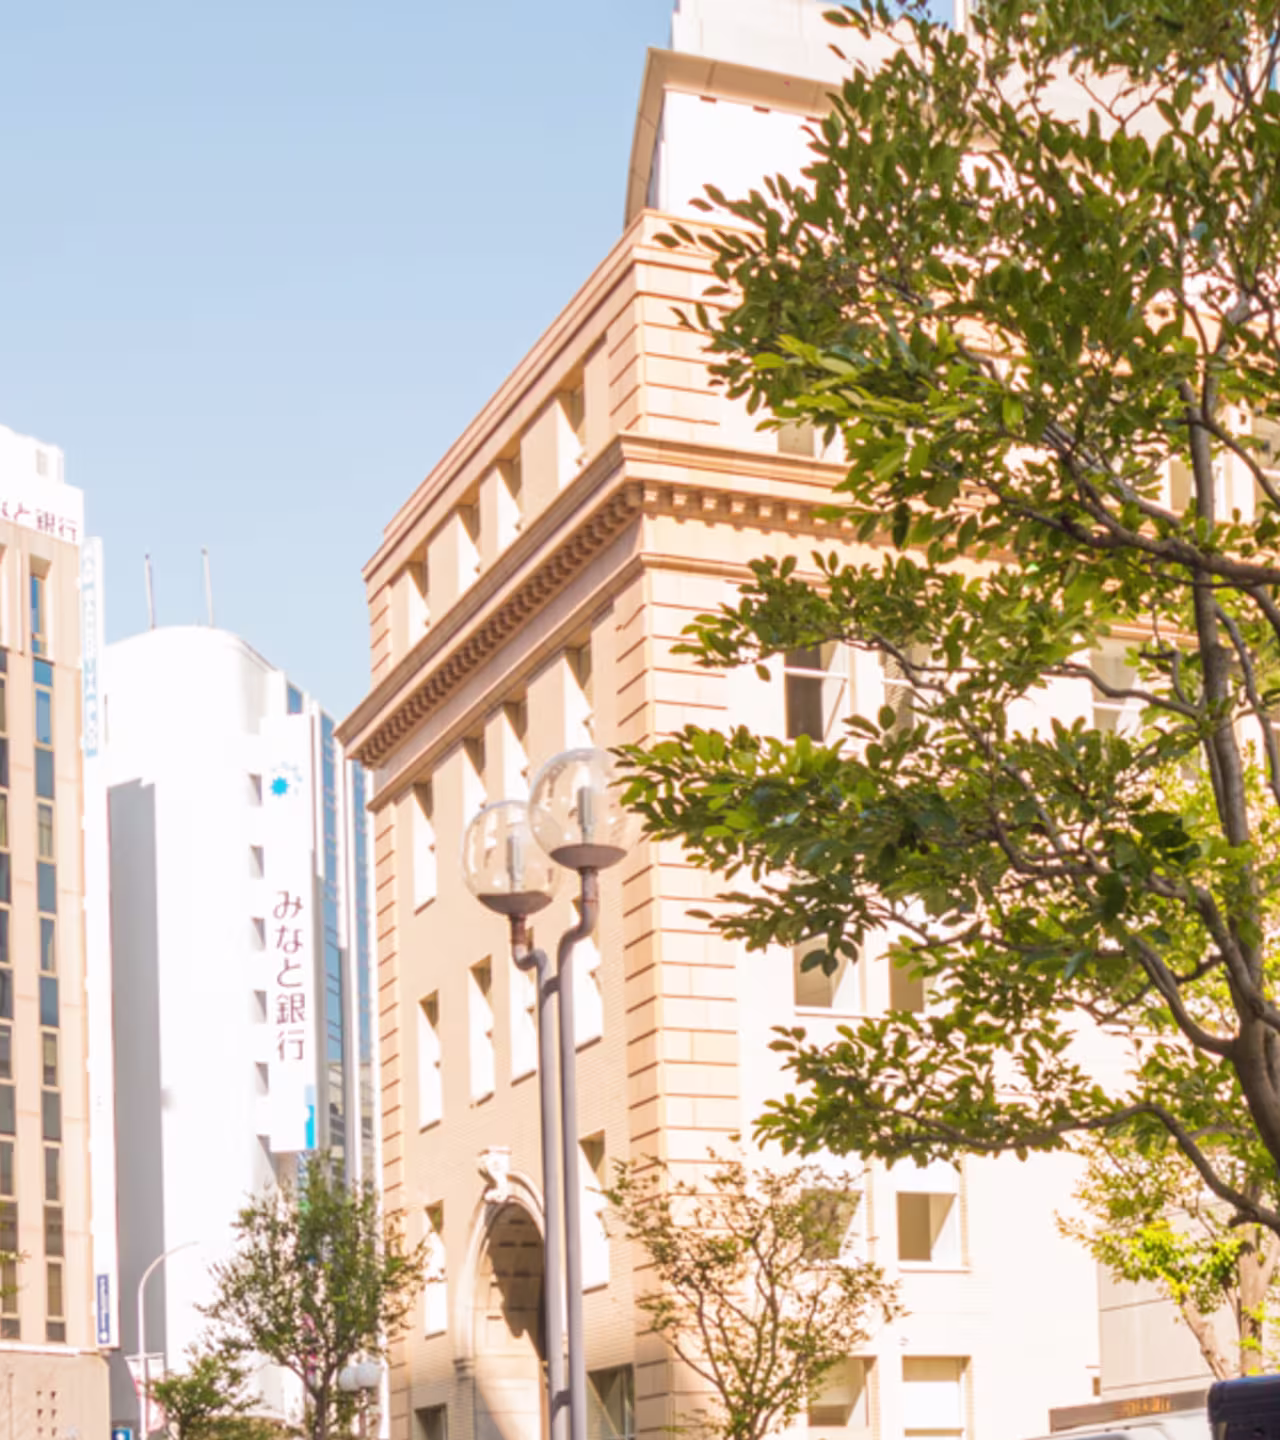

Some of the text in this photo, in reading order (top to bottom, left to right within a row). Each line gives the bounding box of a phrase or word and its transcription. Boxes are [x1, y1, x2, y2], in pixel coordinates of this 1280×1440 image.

[273, 890, 306, 1062] みなと銀行
